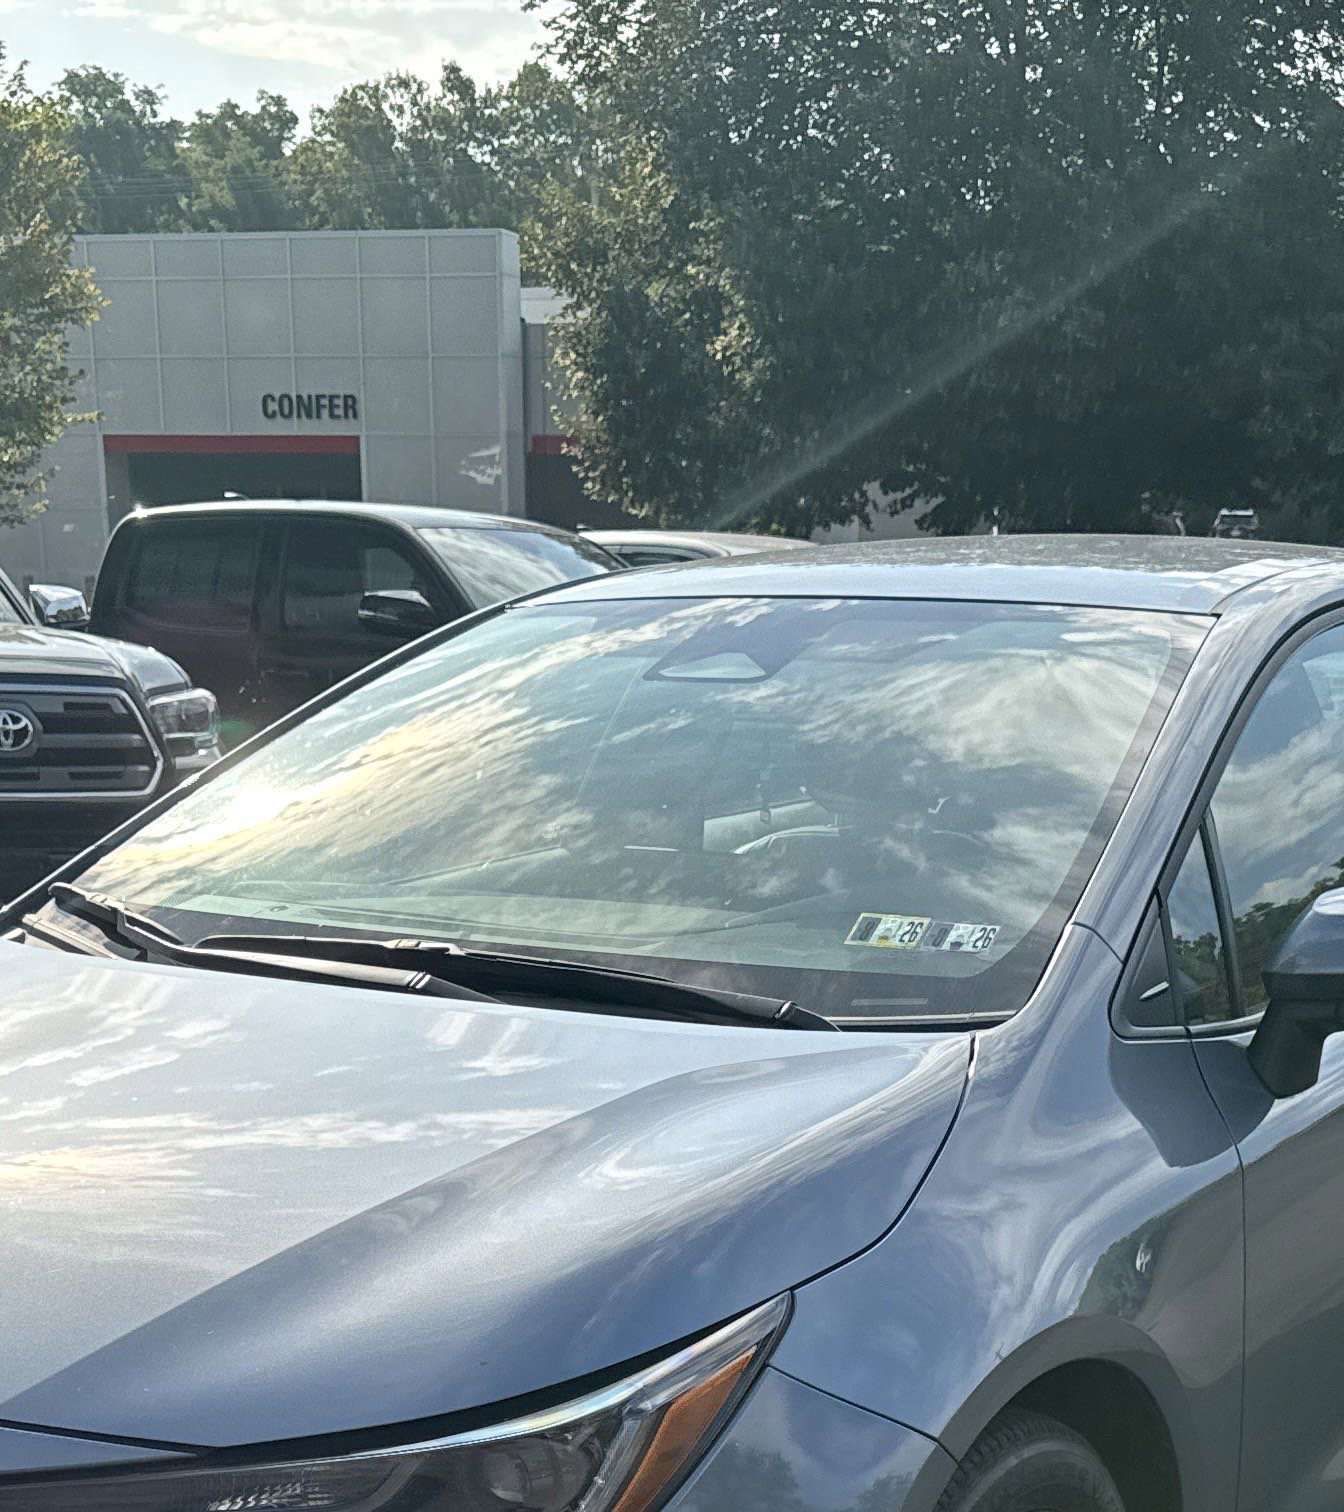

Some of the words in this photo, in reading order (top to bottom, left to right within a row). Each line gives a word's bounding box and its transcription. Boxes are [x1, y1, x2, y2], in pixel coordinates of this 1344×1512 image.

[262, 393, 358, 420] CONFER
[898, 921, 923, 943] 26
[972, 927, 997, 949] 26
